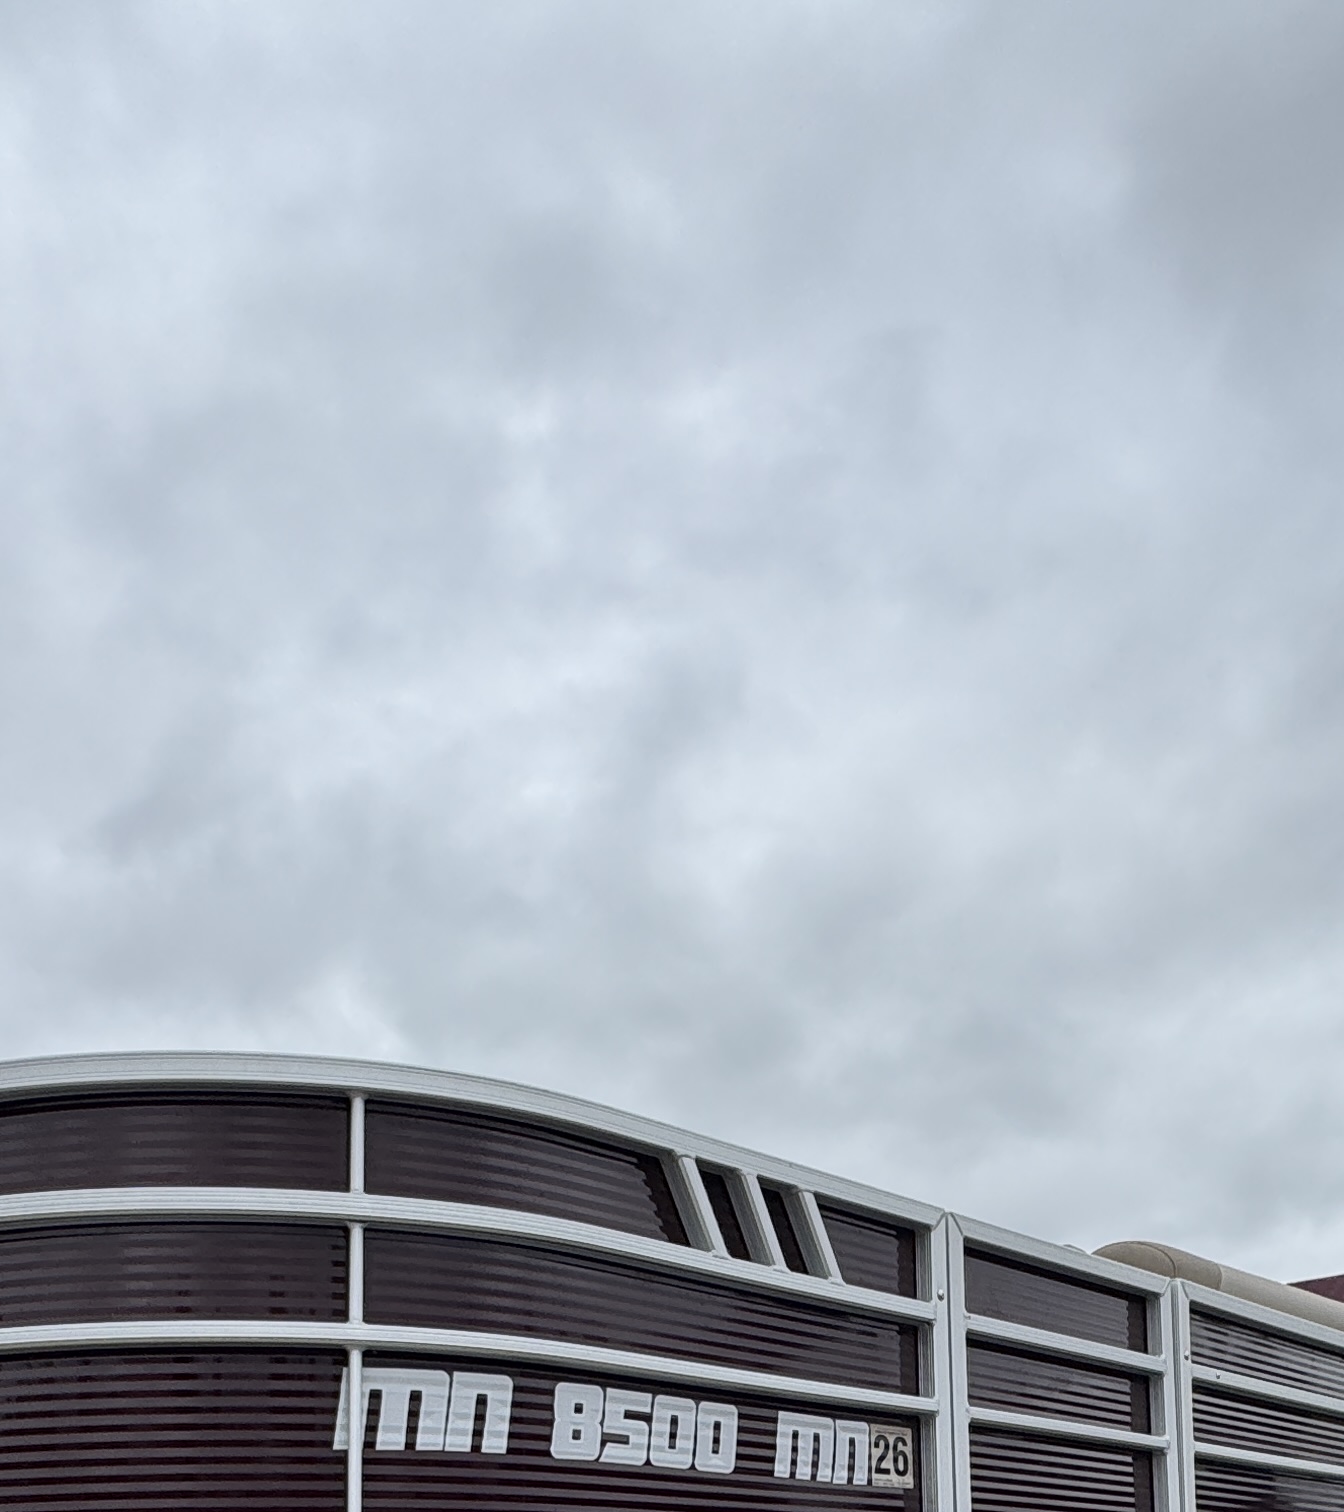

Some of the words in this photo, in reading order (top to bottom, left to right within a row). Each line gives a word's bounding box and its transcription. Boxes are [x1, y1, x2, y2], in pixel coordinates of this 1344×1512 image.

[333, 1367, 514, 1454] MN
[550, 1382, 739, 1474] 8500
[774, 1411, 870, 1485] MN
[873, 1434, 909, 1478] 26
